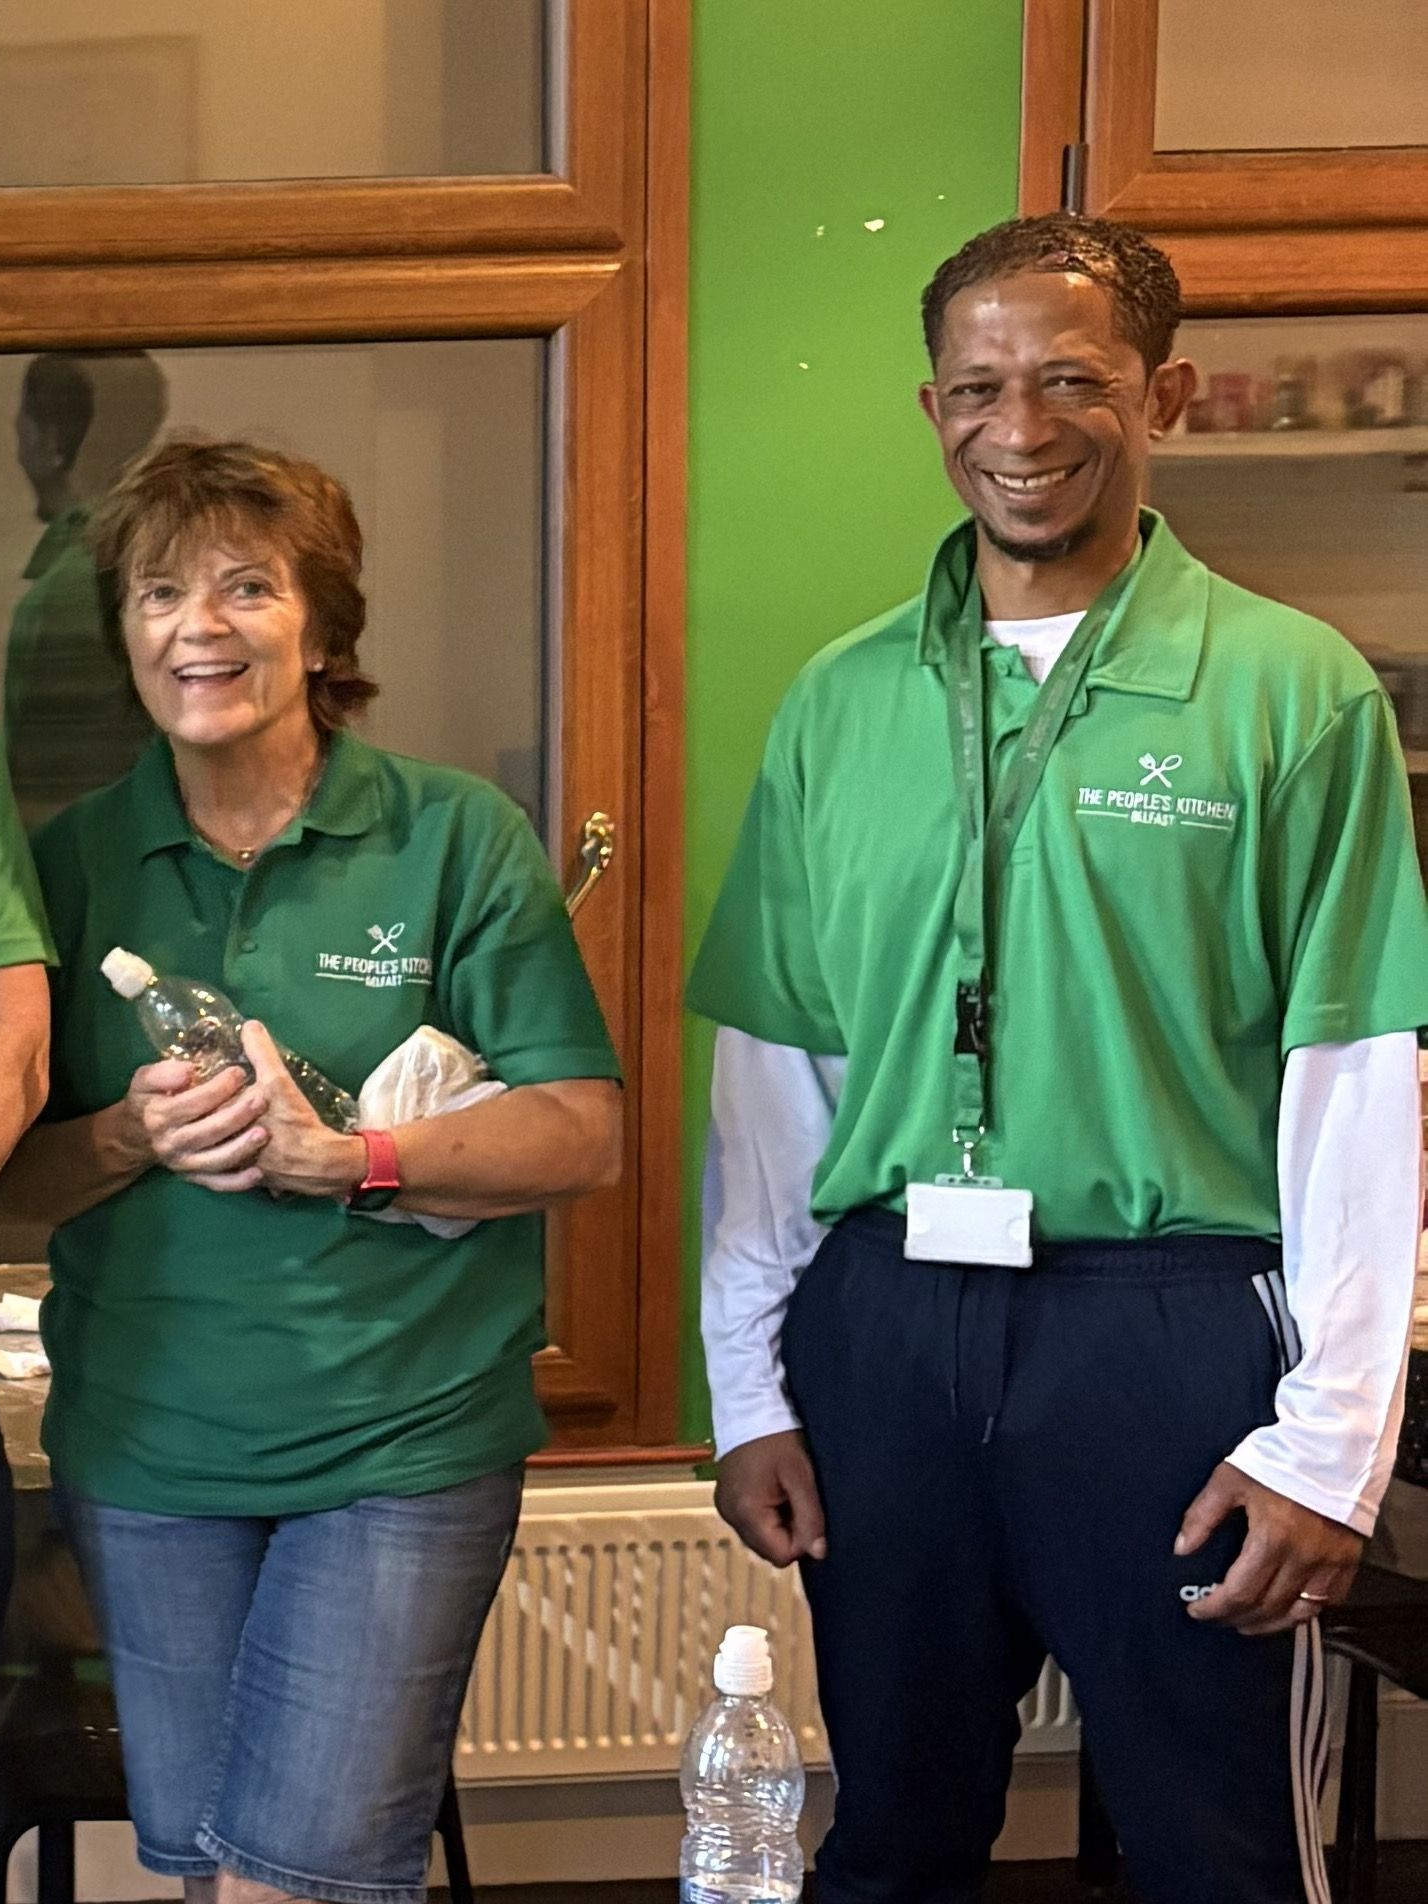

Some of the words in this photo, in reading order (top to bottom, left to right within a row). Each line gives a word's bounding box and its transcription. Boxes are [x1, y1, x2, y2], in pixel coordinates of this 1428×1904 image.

[1078, 787, 1103, 805] THE
[1106, 790, 1172, 812] PEOPLE'S
[1130, 809, 1176, 827] BELFAST
[318, 952, 342, 969] THE
[344, 955, 399, 975] PEOPLE'S
